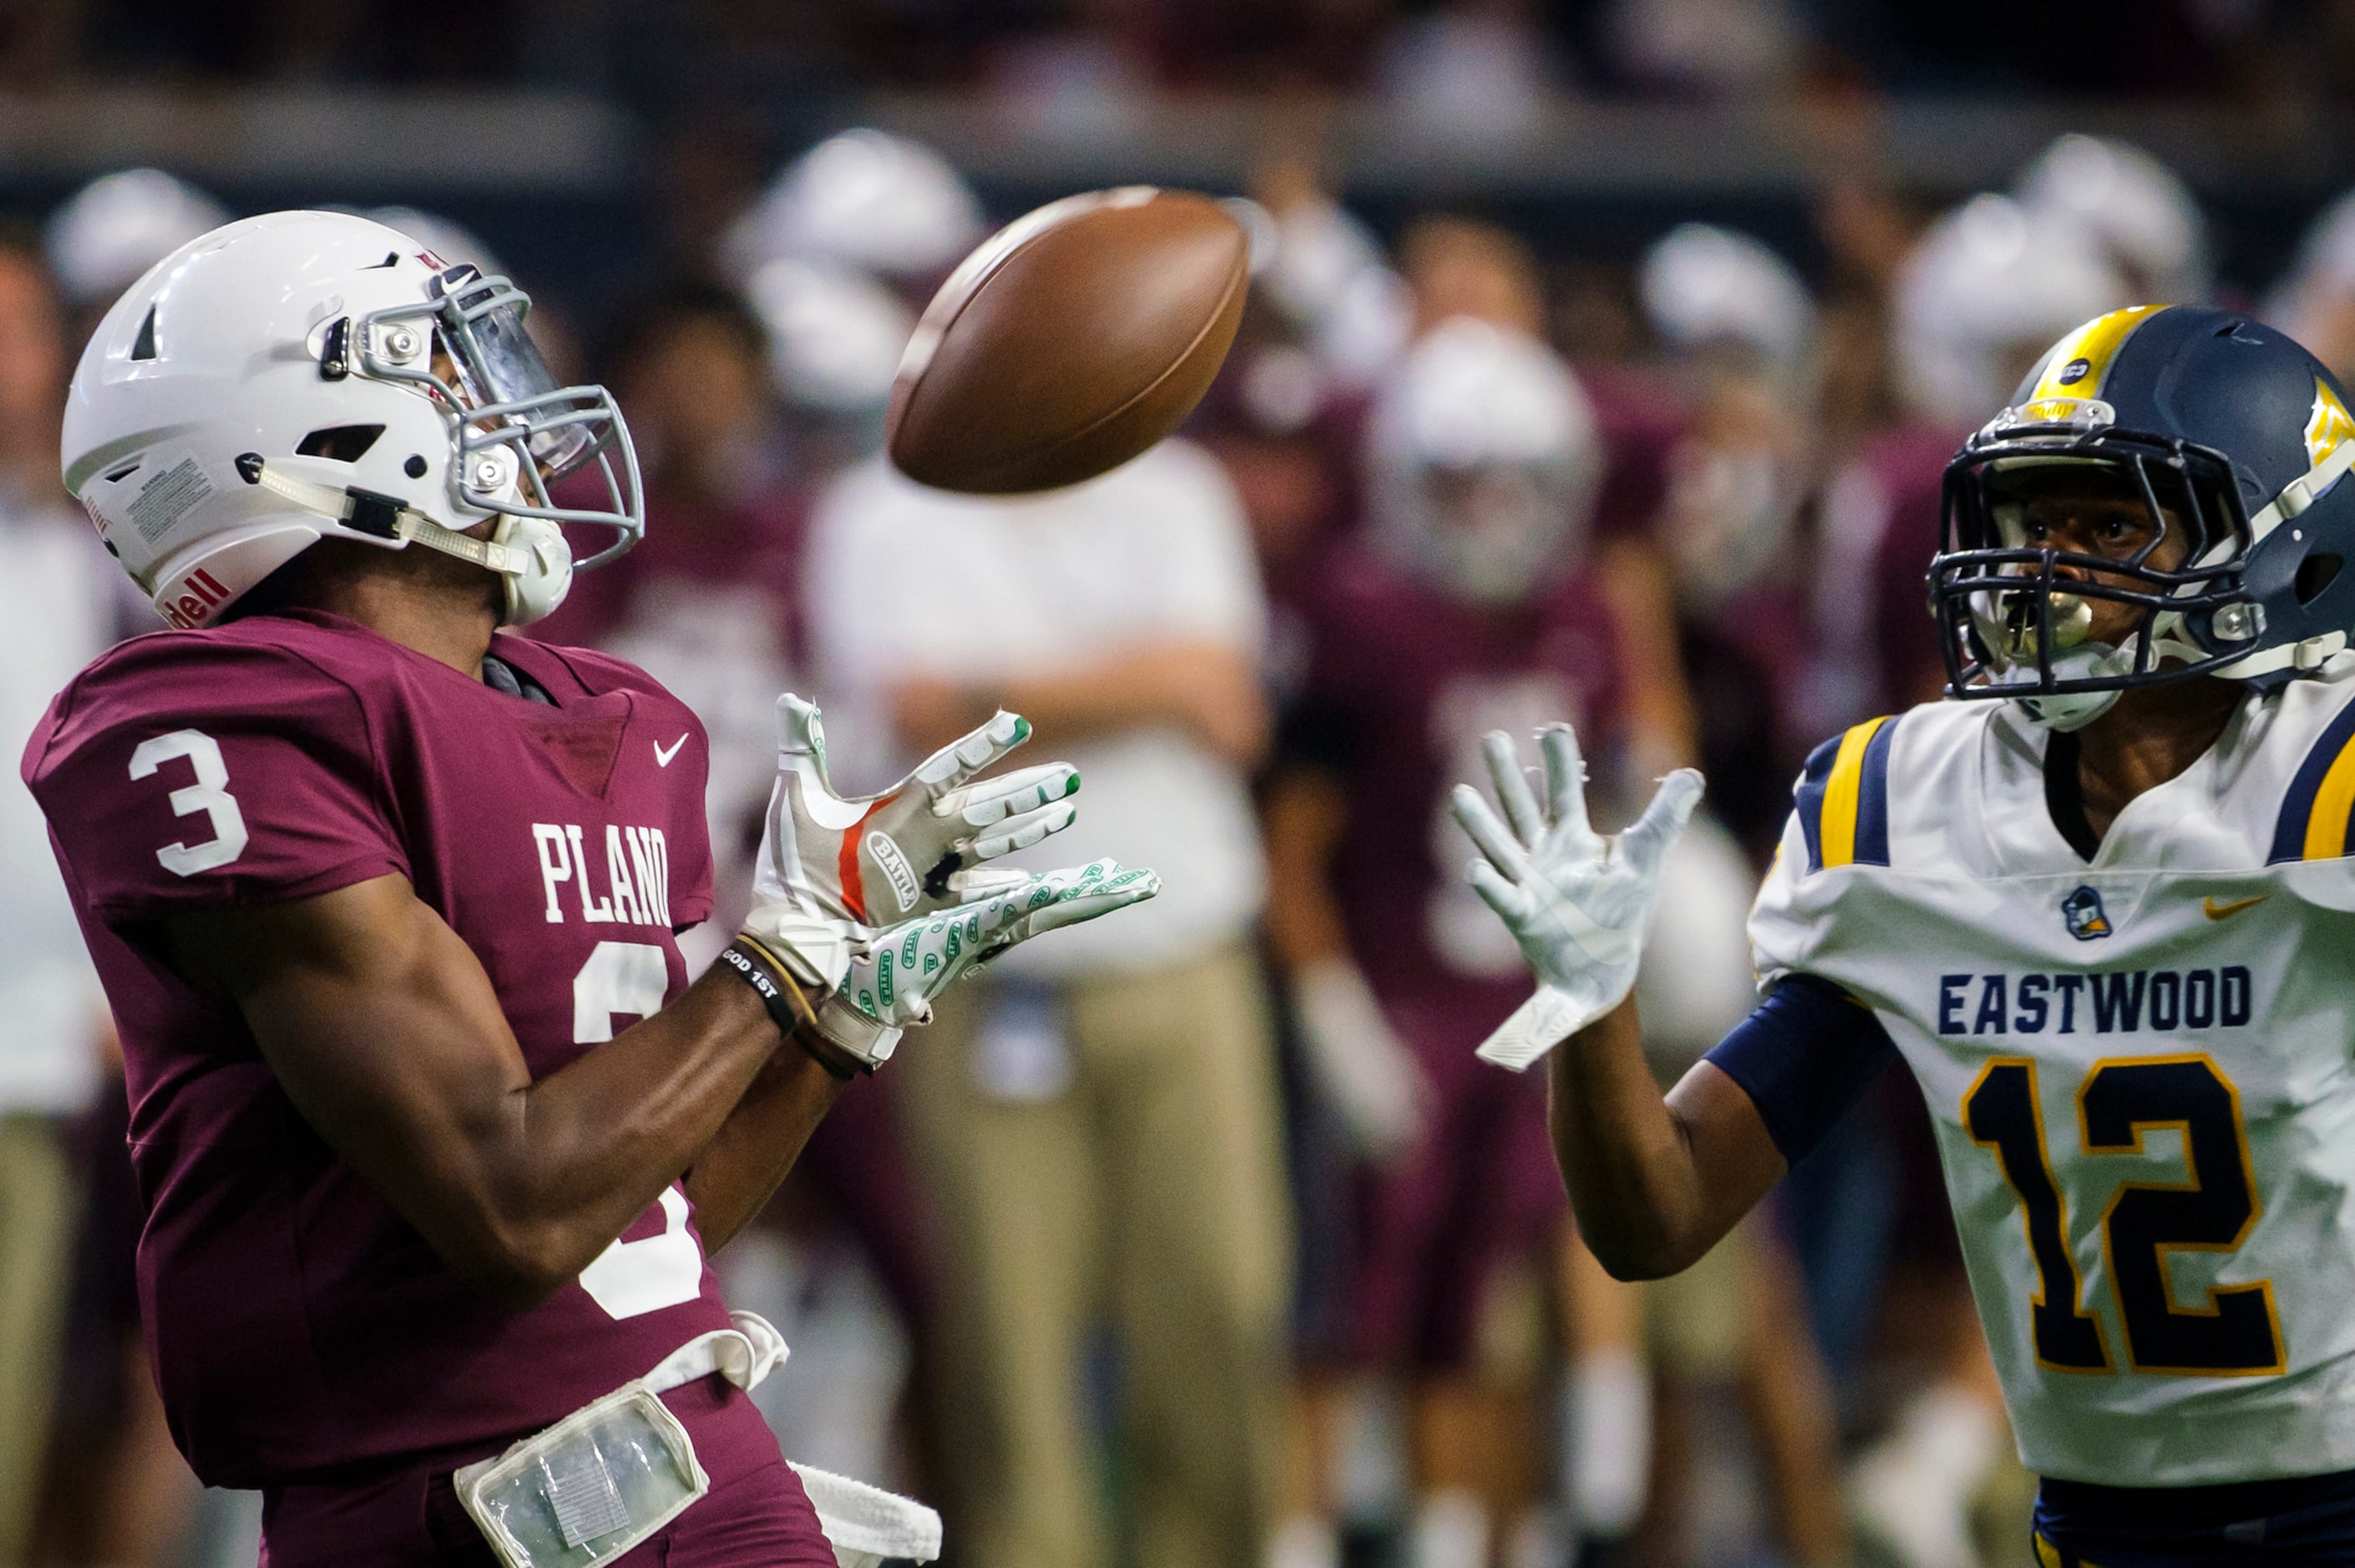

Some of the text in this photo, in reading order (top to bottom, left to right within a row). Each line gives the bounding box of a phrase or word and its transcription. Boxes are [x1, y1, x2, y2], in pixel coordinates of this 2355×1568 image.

[129, 729, 250, 878] 3
[722, 949, 778, 999] GOD 1ST
[881, 954, 892, 1002] BATTLE
[1938, 965, 2251, 1035] EASTWOOD
[1961, 1052, 2287, 1378] 12
